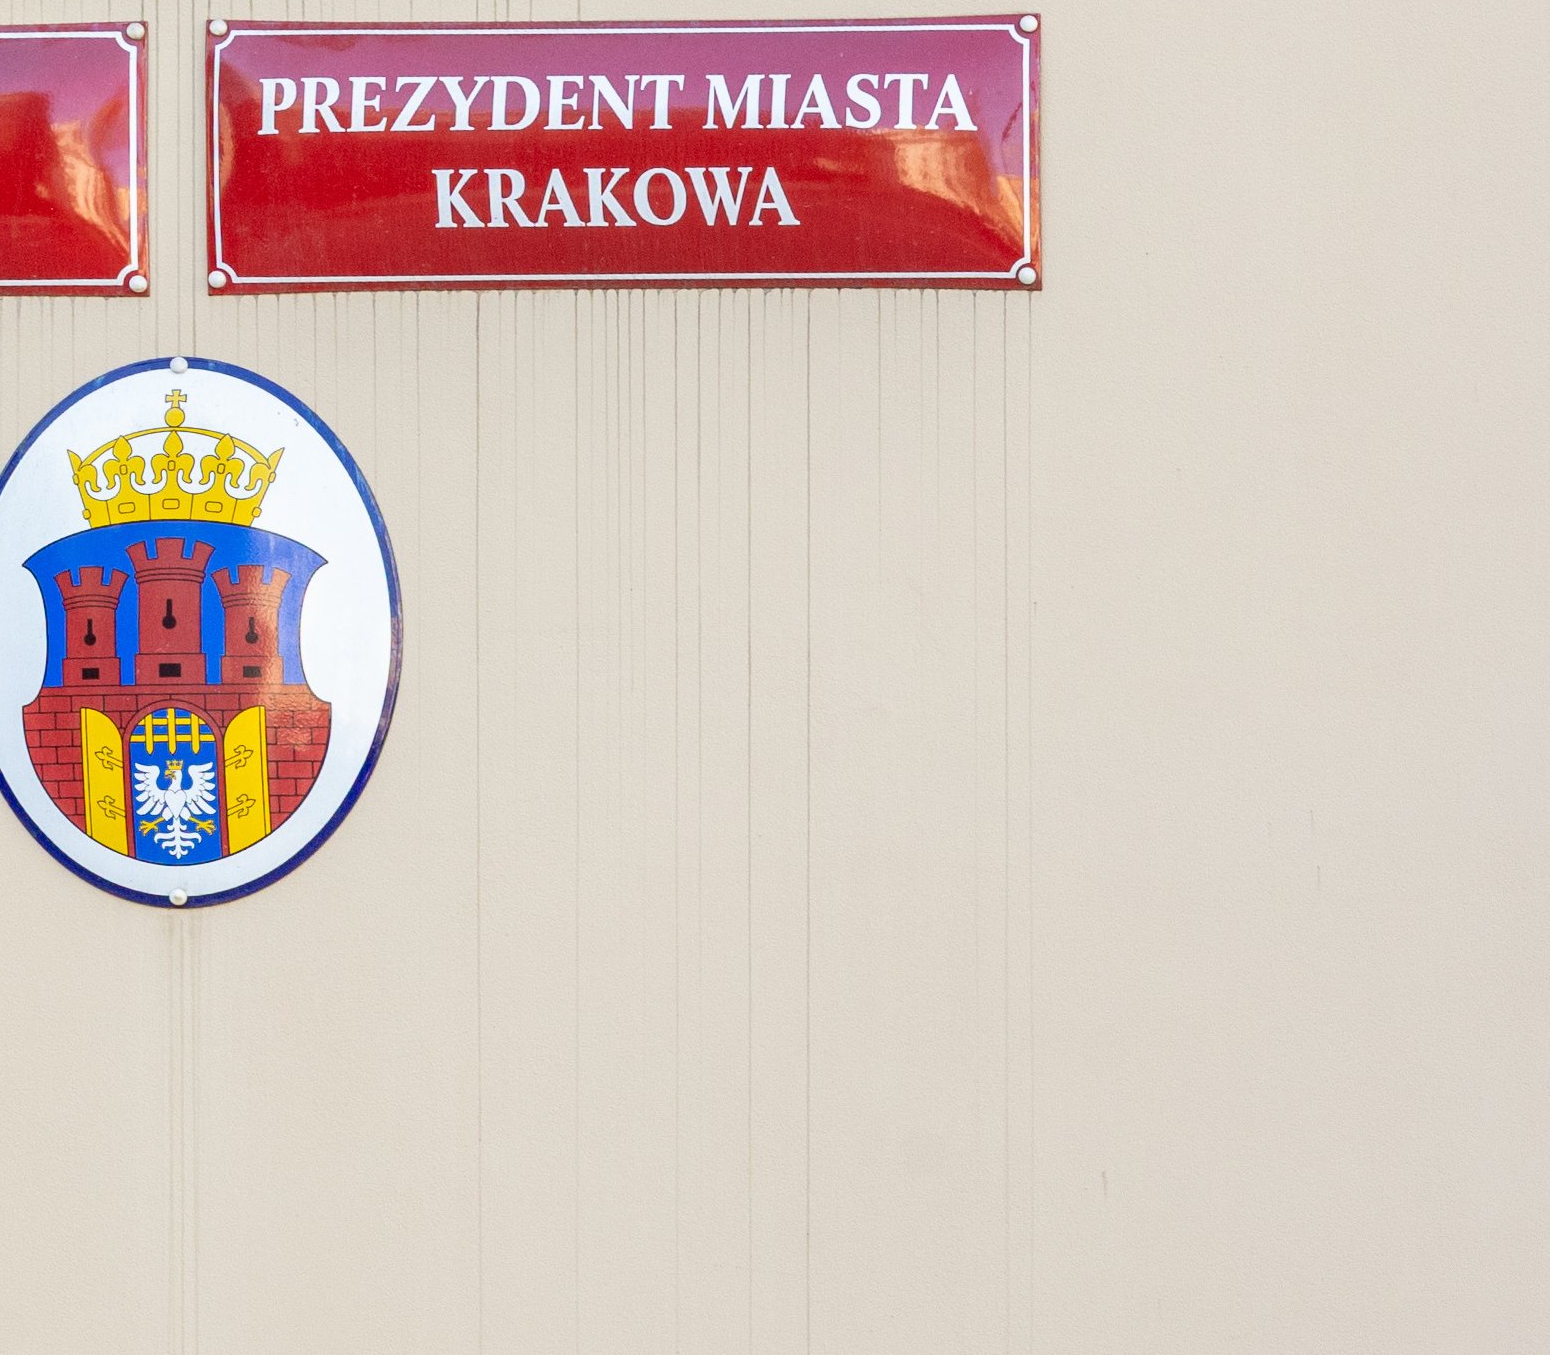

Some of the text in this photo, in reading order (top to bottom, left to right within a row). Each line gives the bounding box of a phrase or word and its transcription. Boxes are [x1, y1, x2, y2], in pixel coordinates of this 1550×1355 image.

[257, 73, 979, 136] PREZYDENT MIASTA
[431, 166, 801, 229] KRAKOWA
